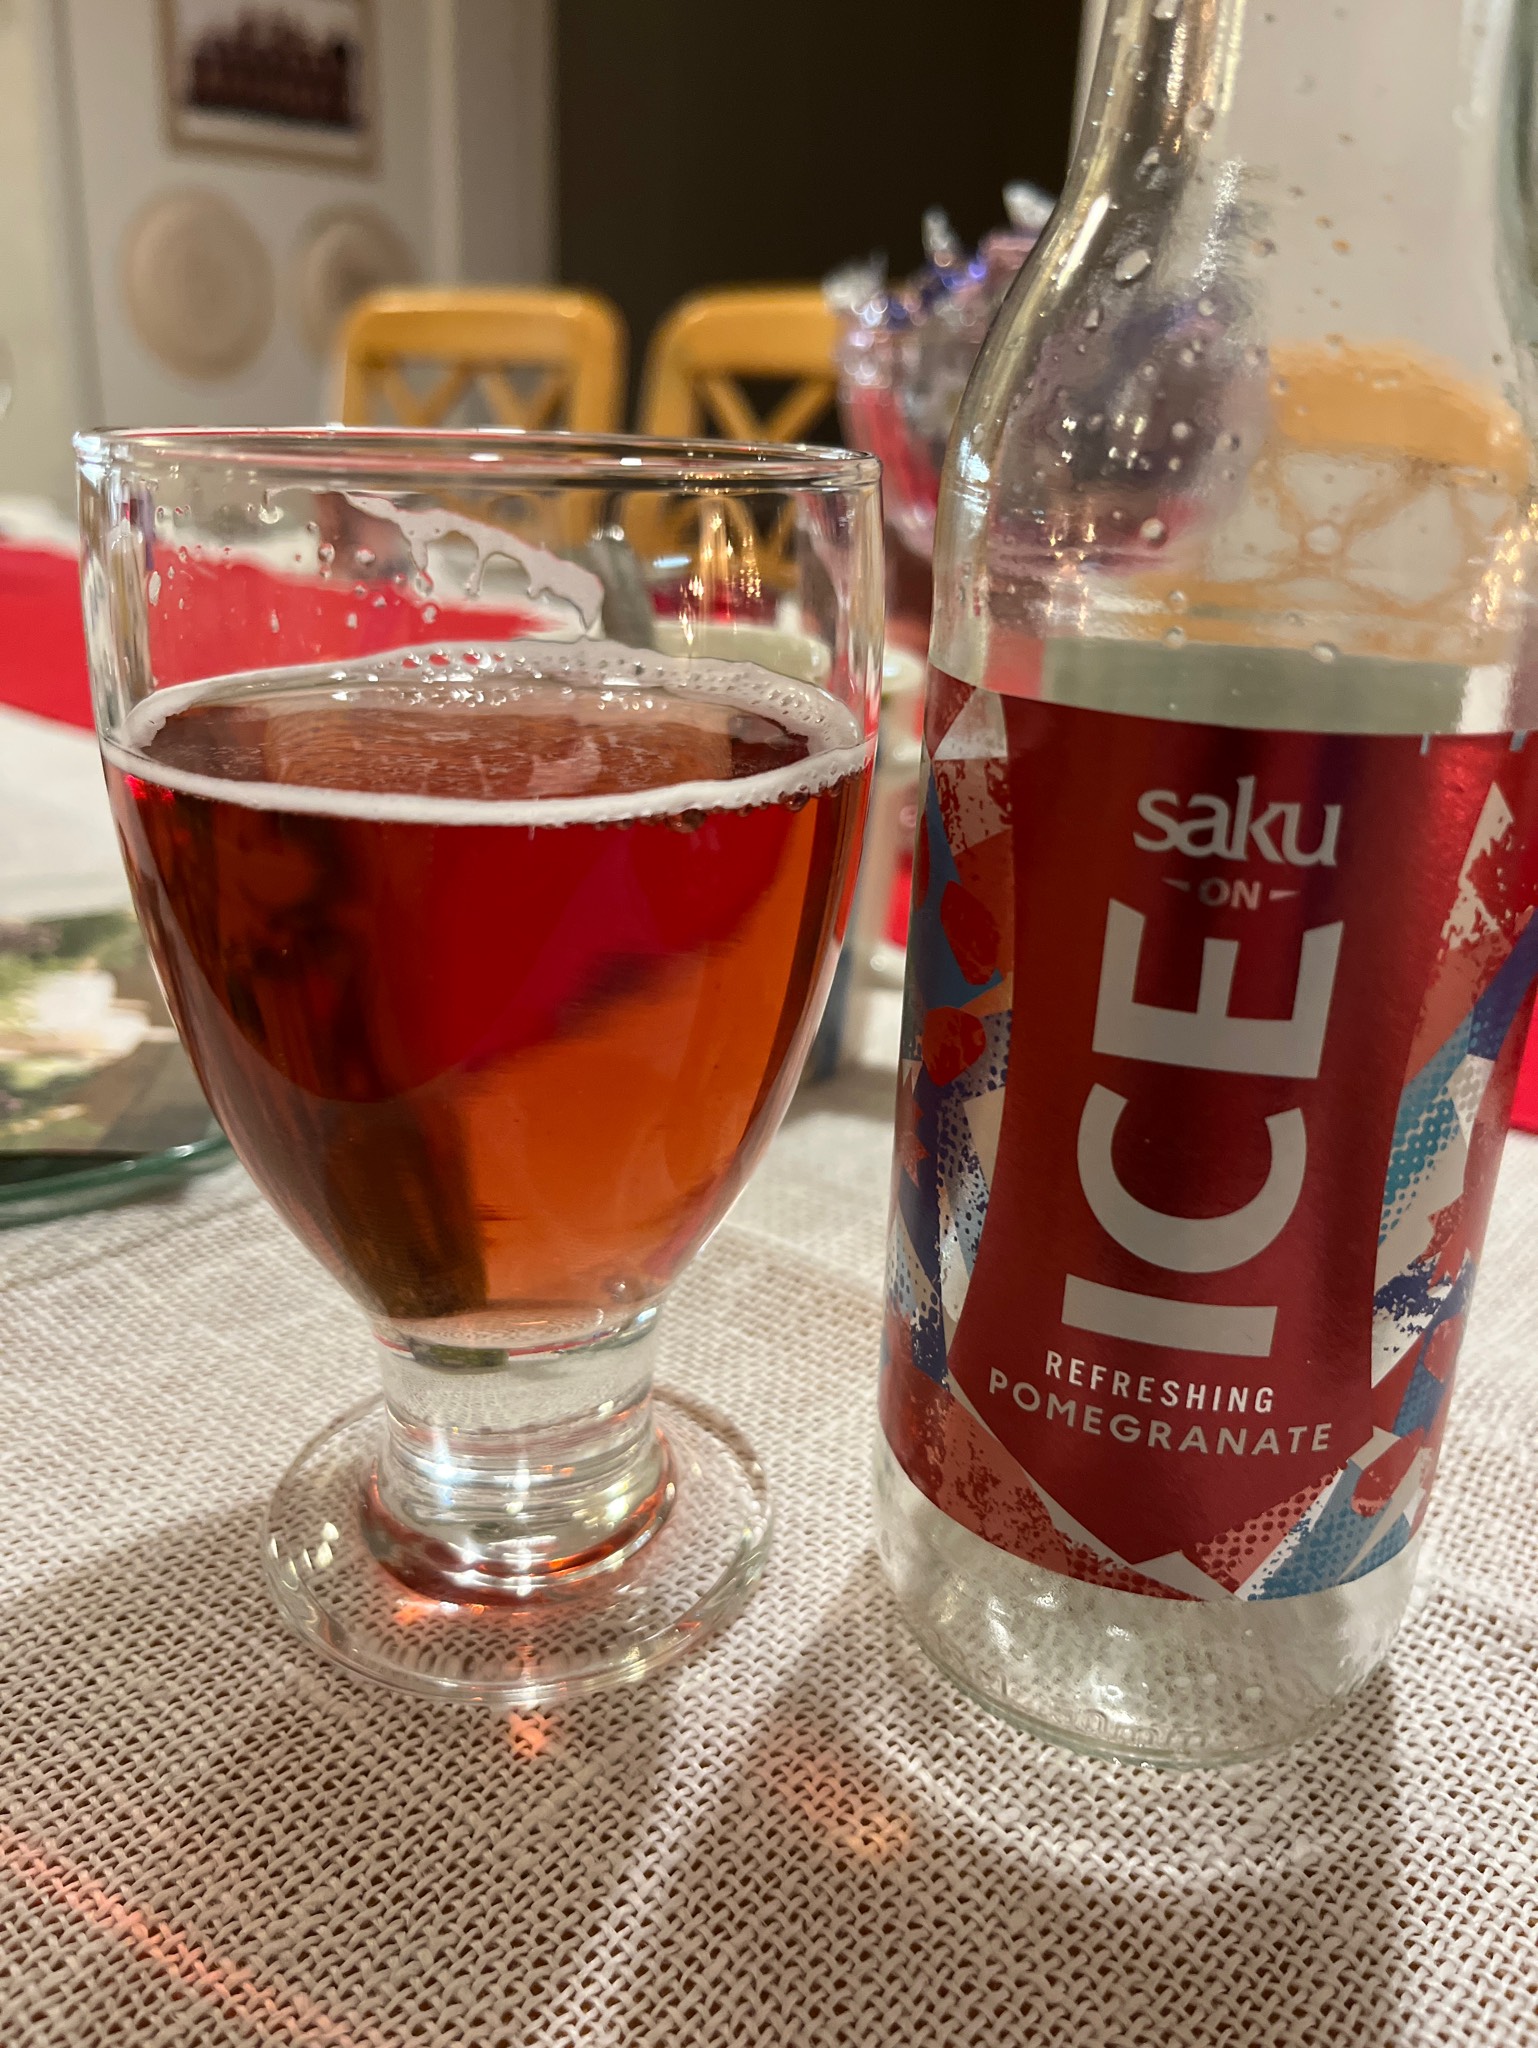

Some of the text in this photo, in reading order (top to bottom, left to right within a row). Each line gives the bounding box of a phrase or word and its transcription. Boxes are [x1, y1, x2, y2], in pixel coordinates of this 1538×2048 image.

[1133, 775, 1342, 866] saku
[1200, 879, 1259, 911] ON
[1061, 898, 1344, 1357] ICE
[989, 1367, 1333, 1456] POMEGRANATE
[1045, 1350, 1274, 1414] REFRESHING
